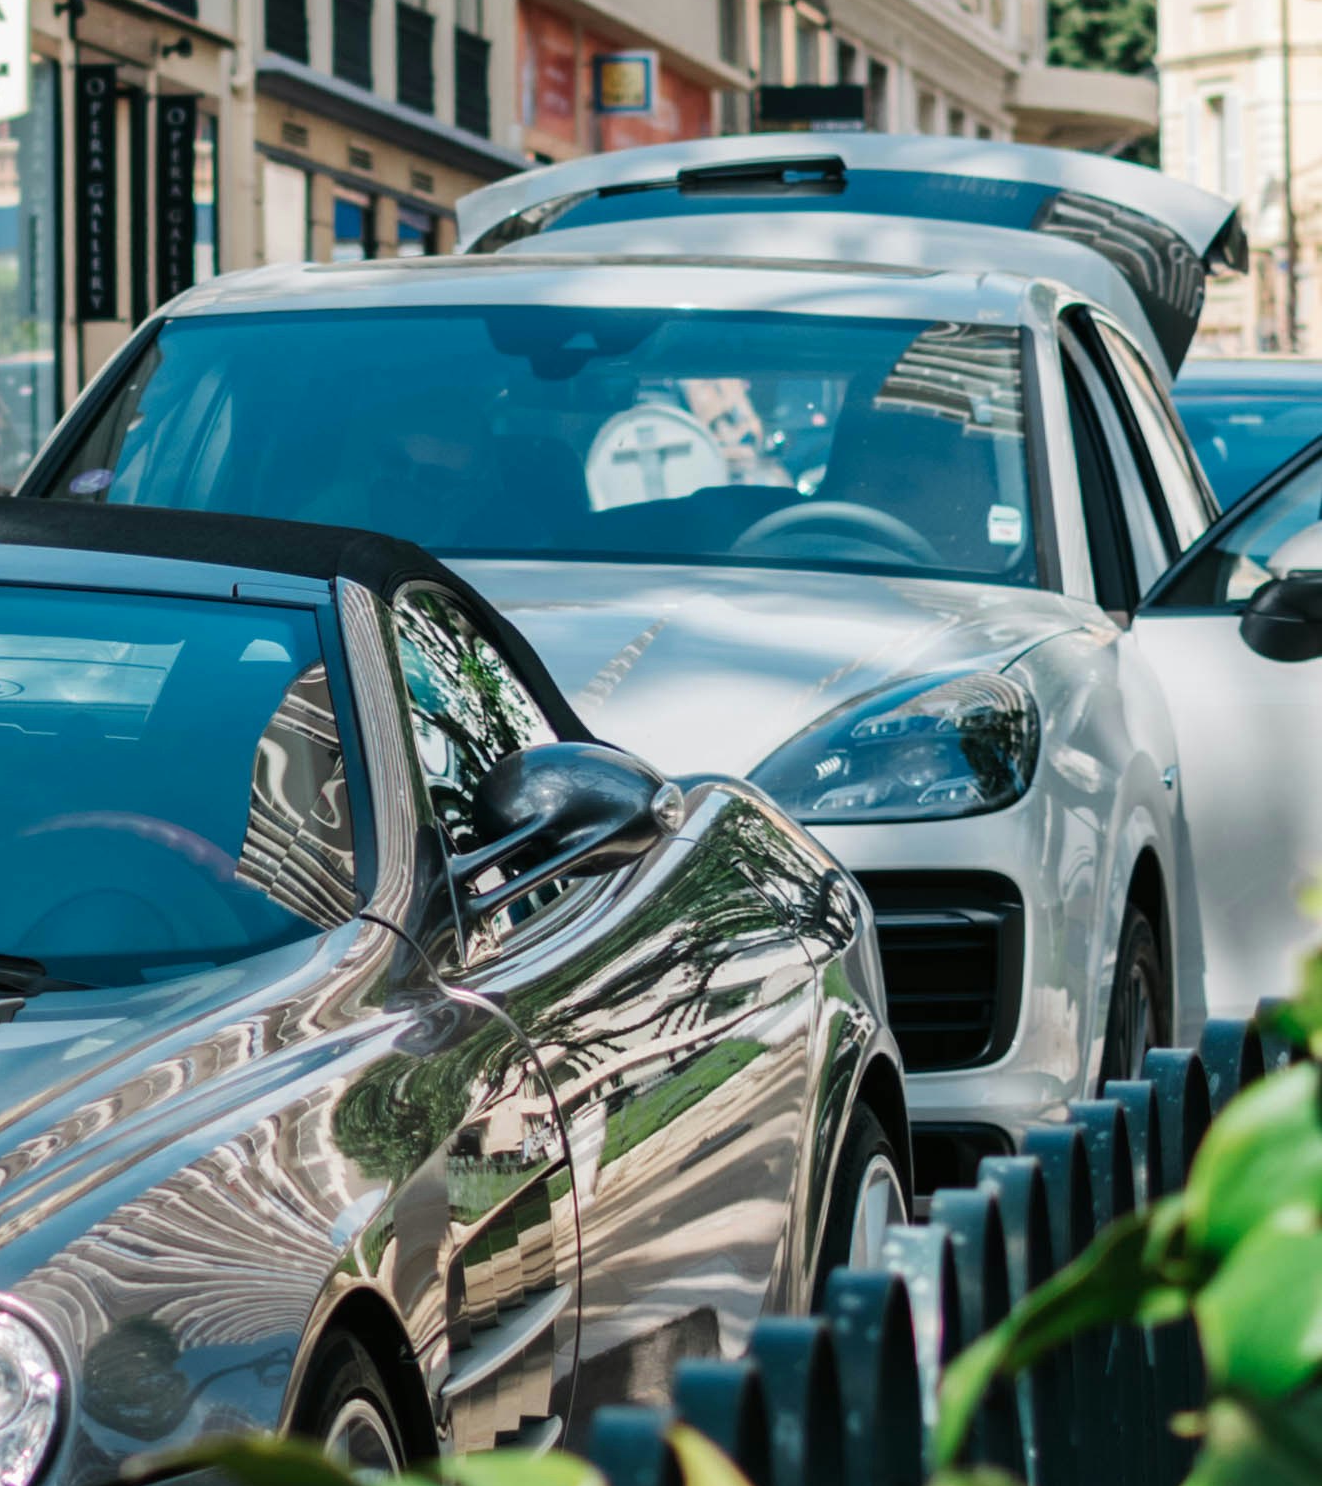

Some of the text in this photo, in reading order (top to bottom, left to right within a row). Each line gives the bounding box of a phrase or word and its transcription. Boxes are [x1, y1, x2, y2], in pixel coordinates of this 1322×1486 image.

[86, 77, 105, 311] OPERA GALLERY
[167, 208, 183, 294] GALLE
